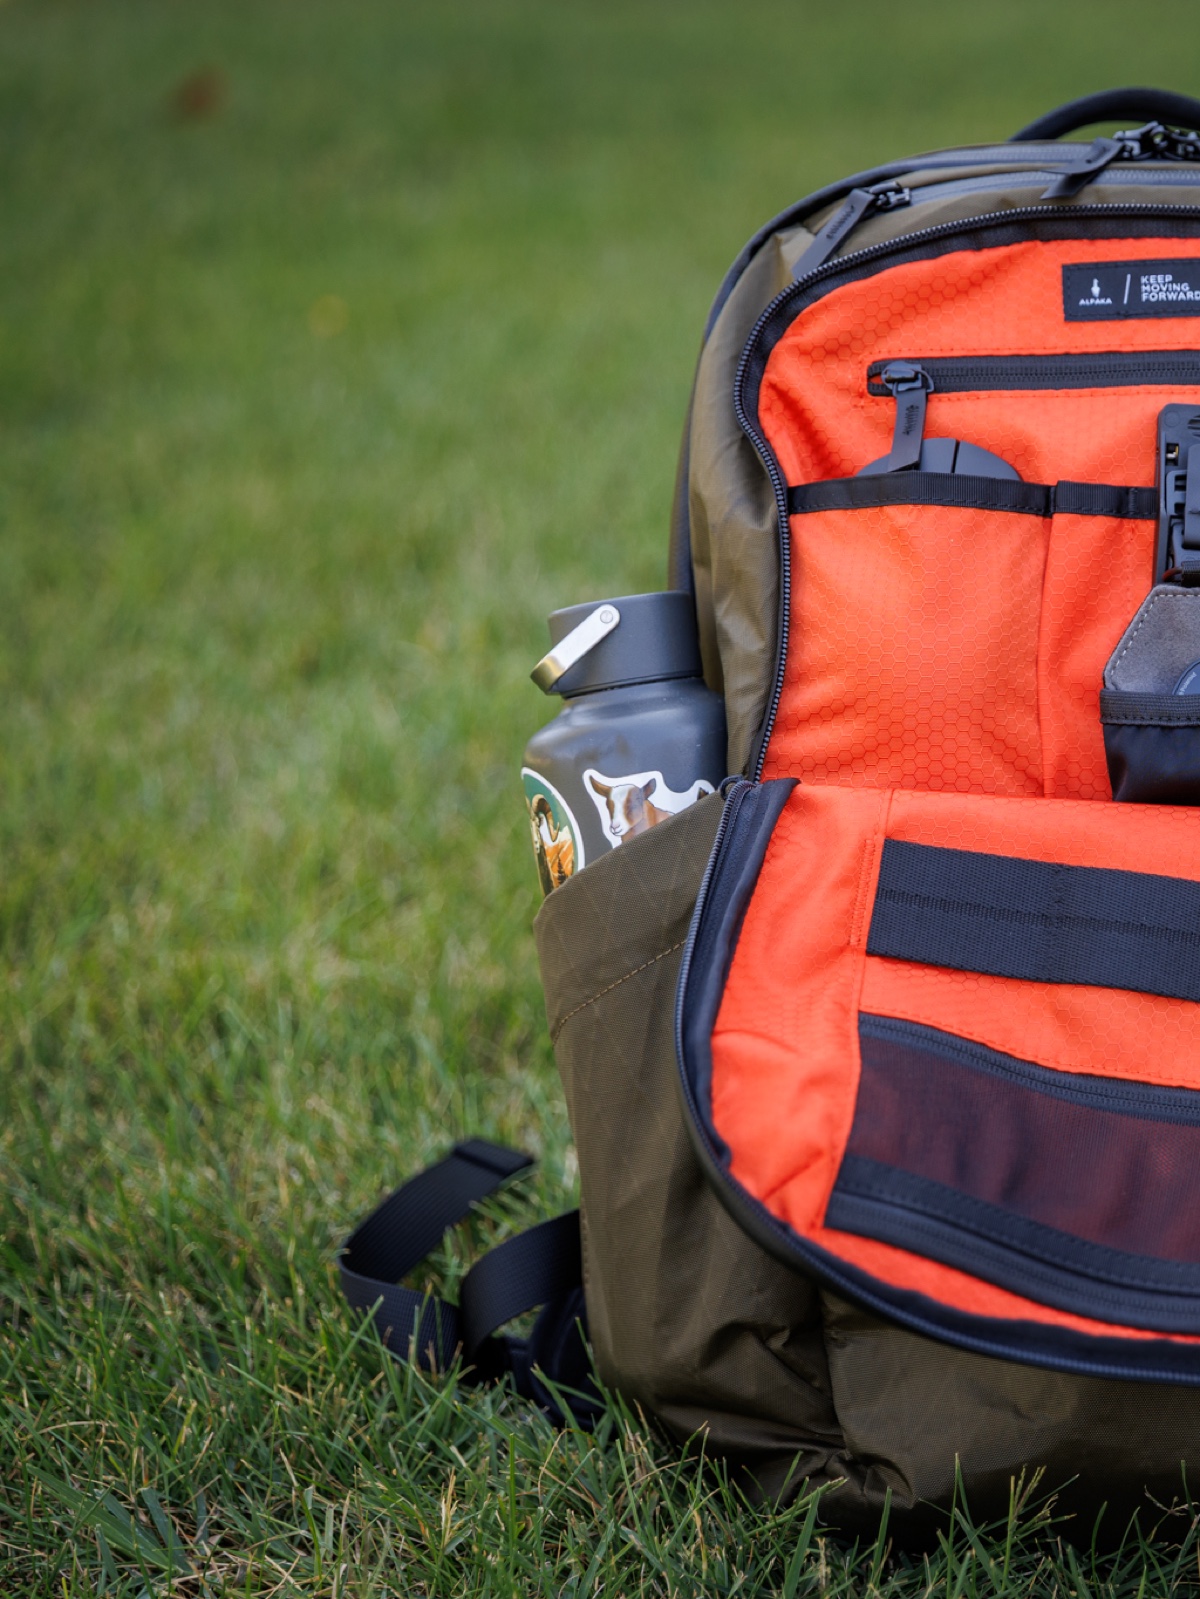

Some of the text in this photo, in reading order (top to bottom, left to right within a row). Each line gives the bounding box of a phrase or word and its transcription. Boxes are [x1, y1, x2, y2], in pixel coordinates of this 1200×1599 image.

[1140, 274, 1173, 284] KEEP
[1141, 282, 1190, 292] MOVING
[1079, 297, 1112, 306] ALPAKA
